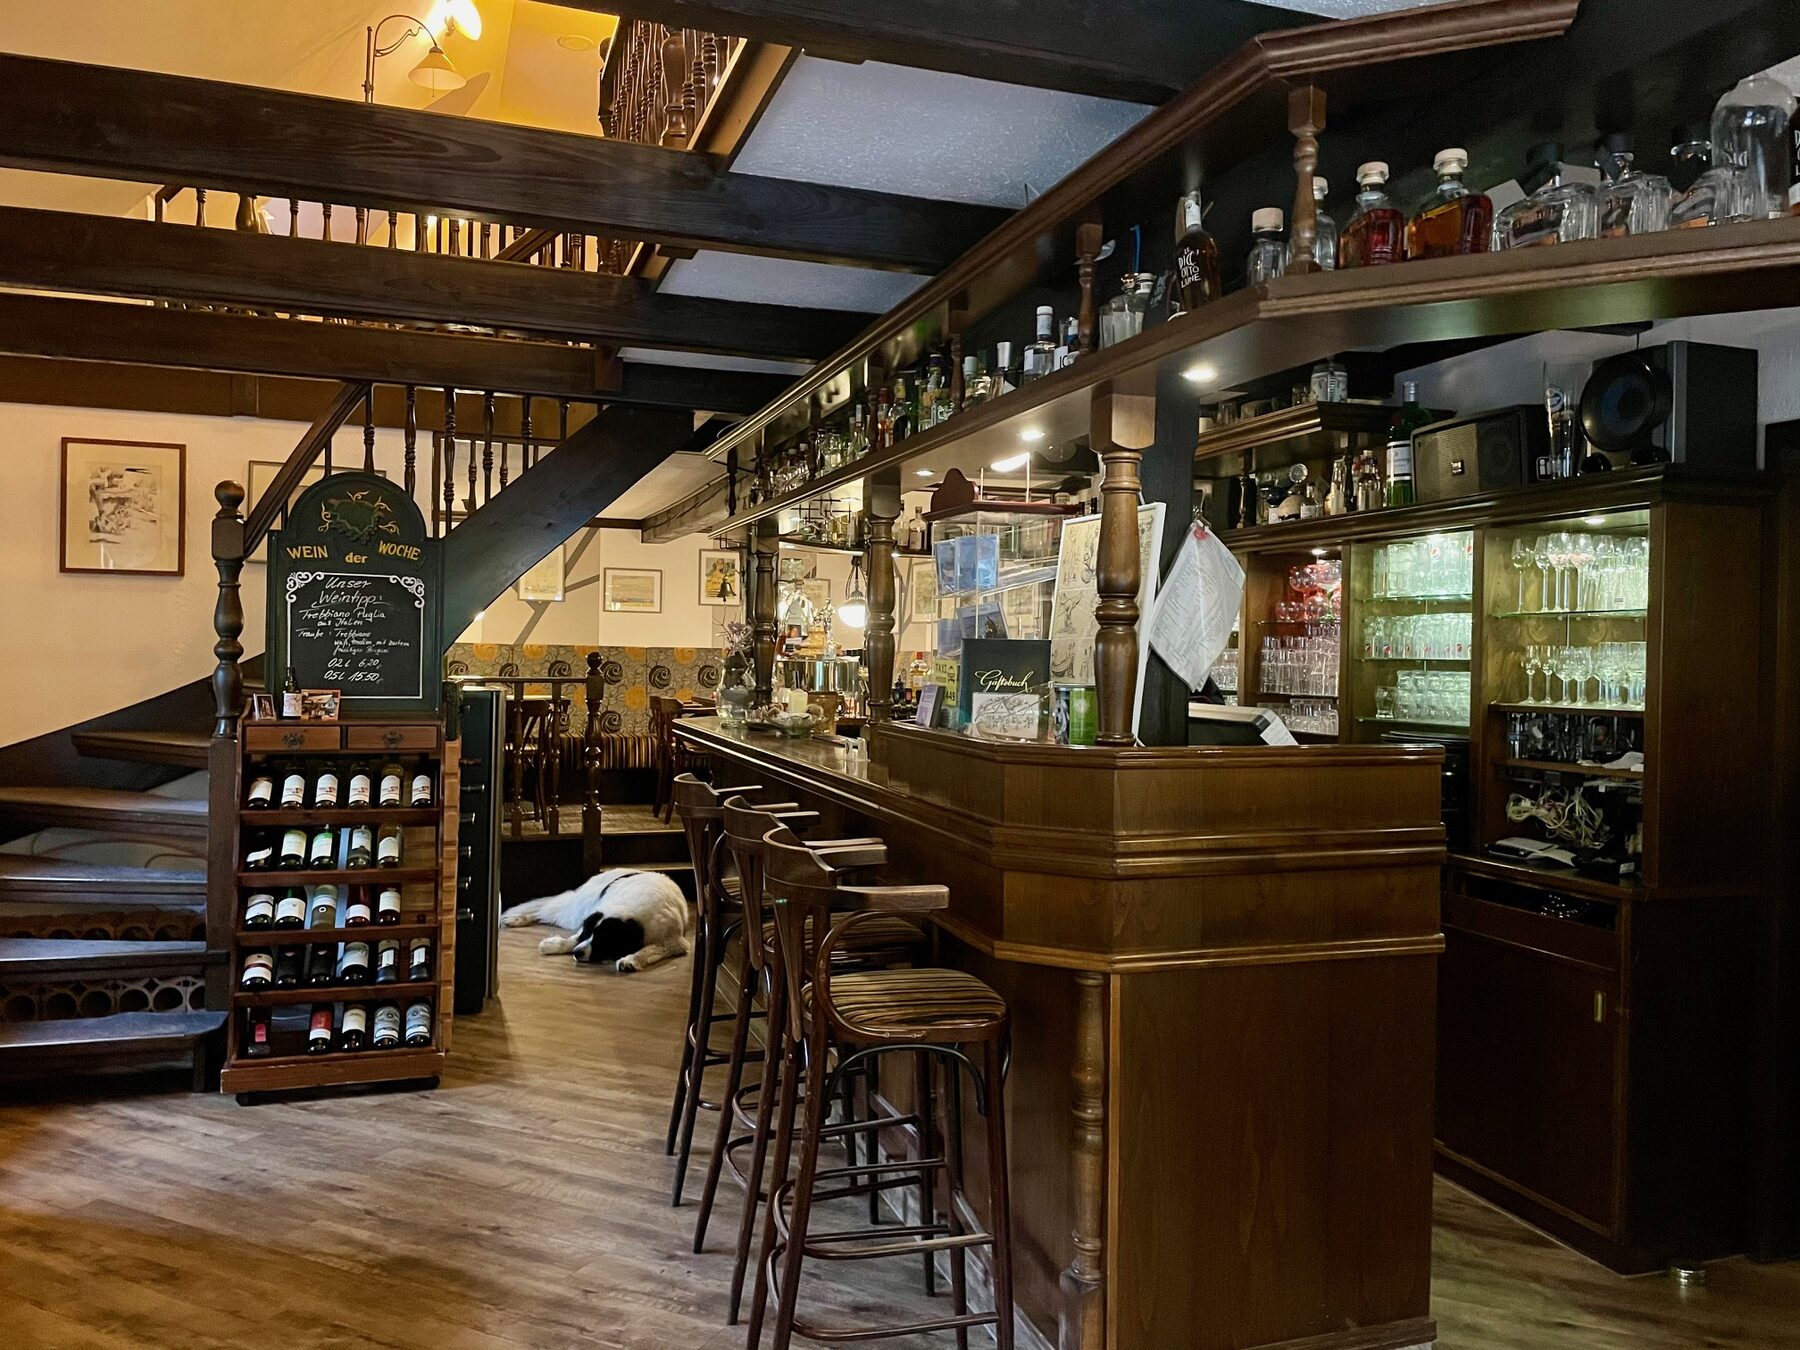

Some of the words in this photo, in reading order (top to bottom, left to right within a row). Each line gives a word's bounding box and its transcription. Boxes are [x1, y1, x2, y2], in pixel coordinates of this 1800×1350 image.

[287, 545, 329, 559] WEIN
[345, 552, 368, 564] der
[379, 540, 421, 561] WOCHE
[325, 576, 372, 589] Unser
[299, 608, 350, 621] Trebbiano
[353, 606, 386, 623] Puglia
